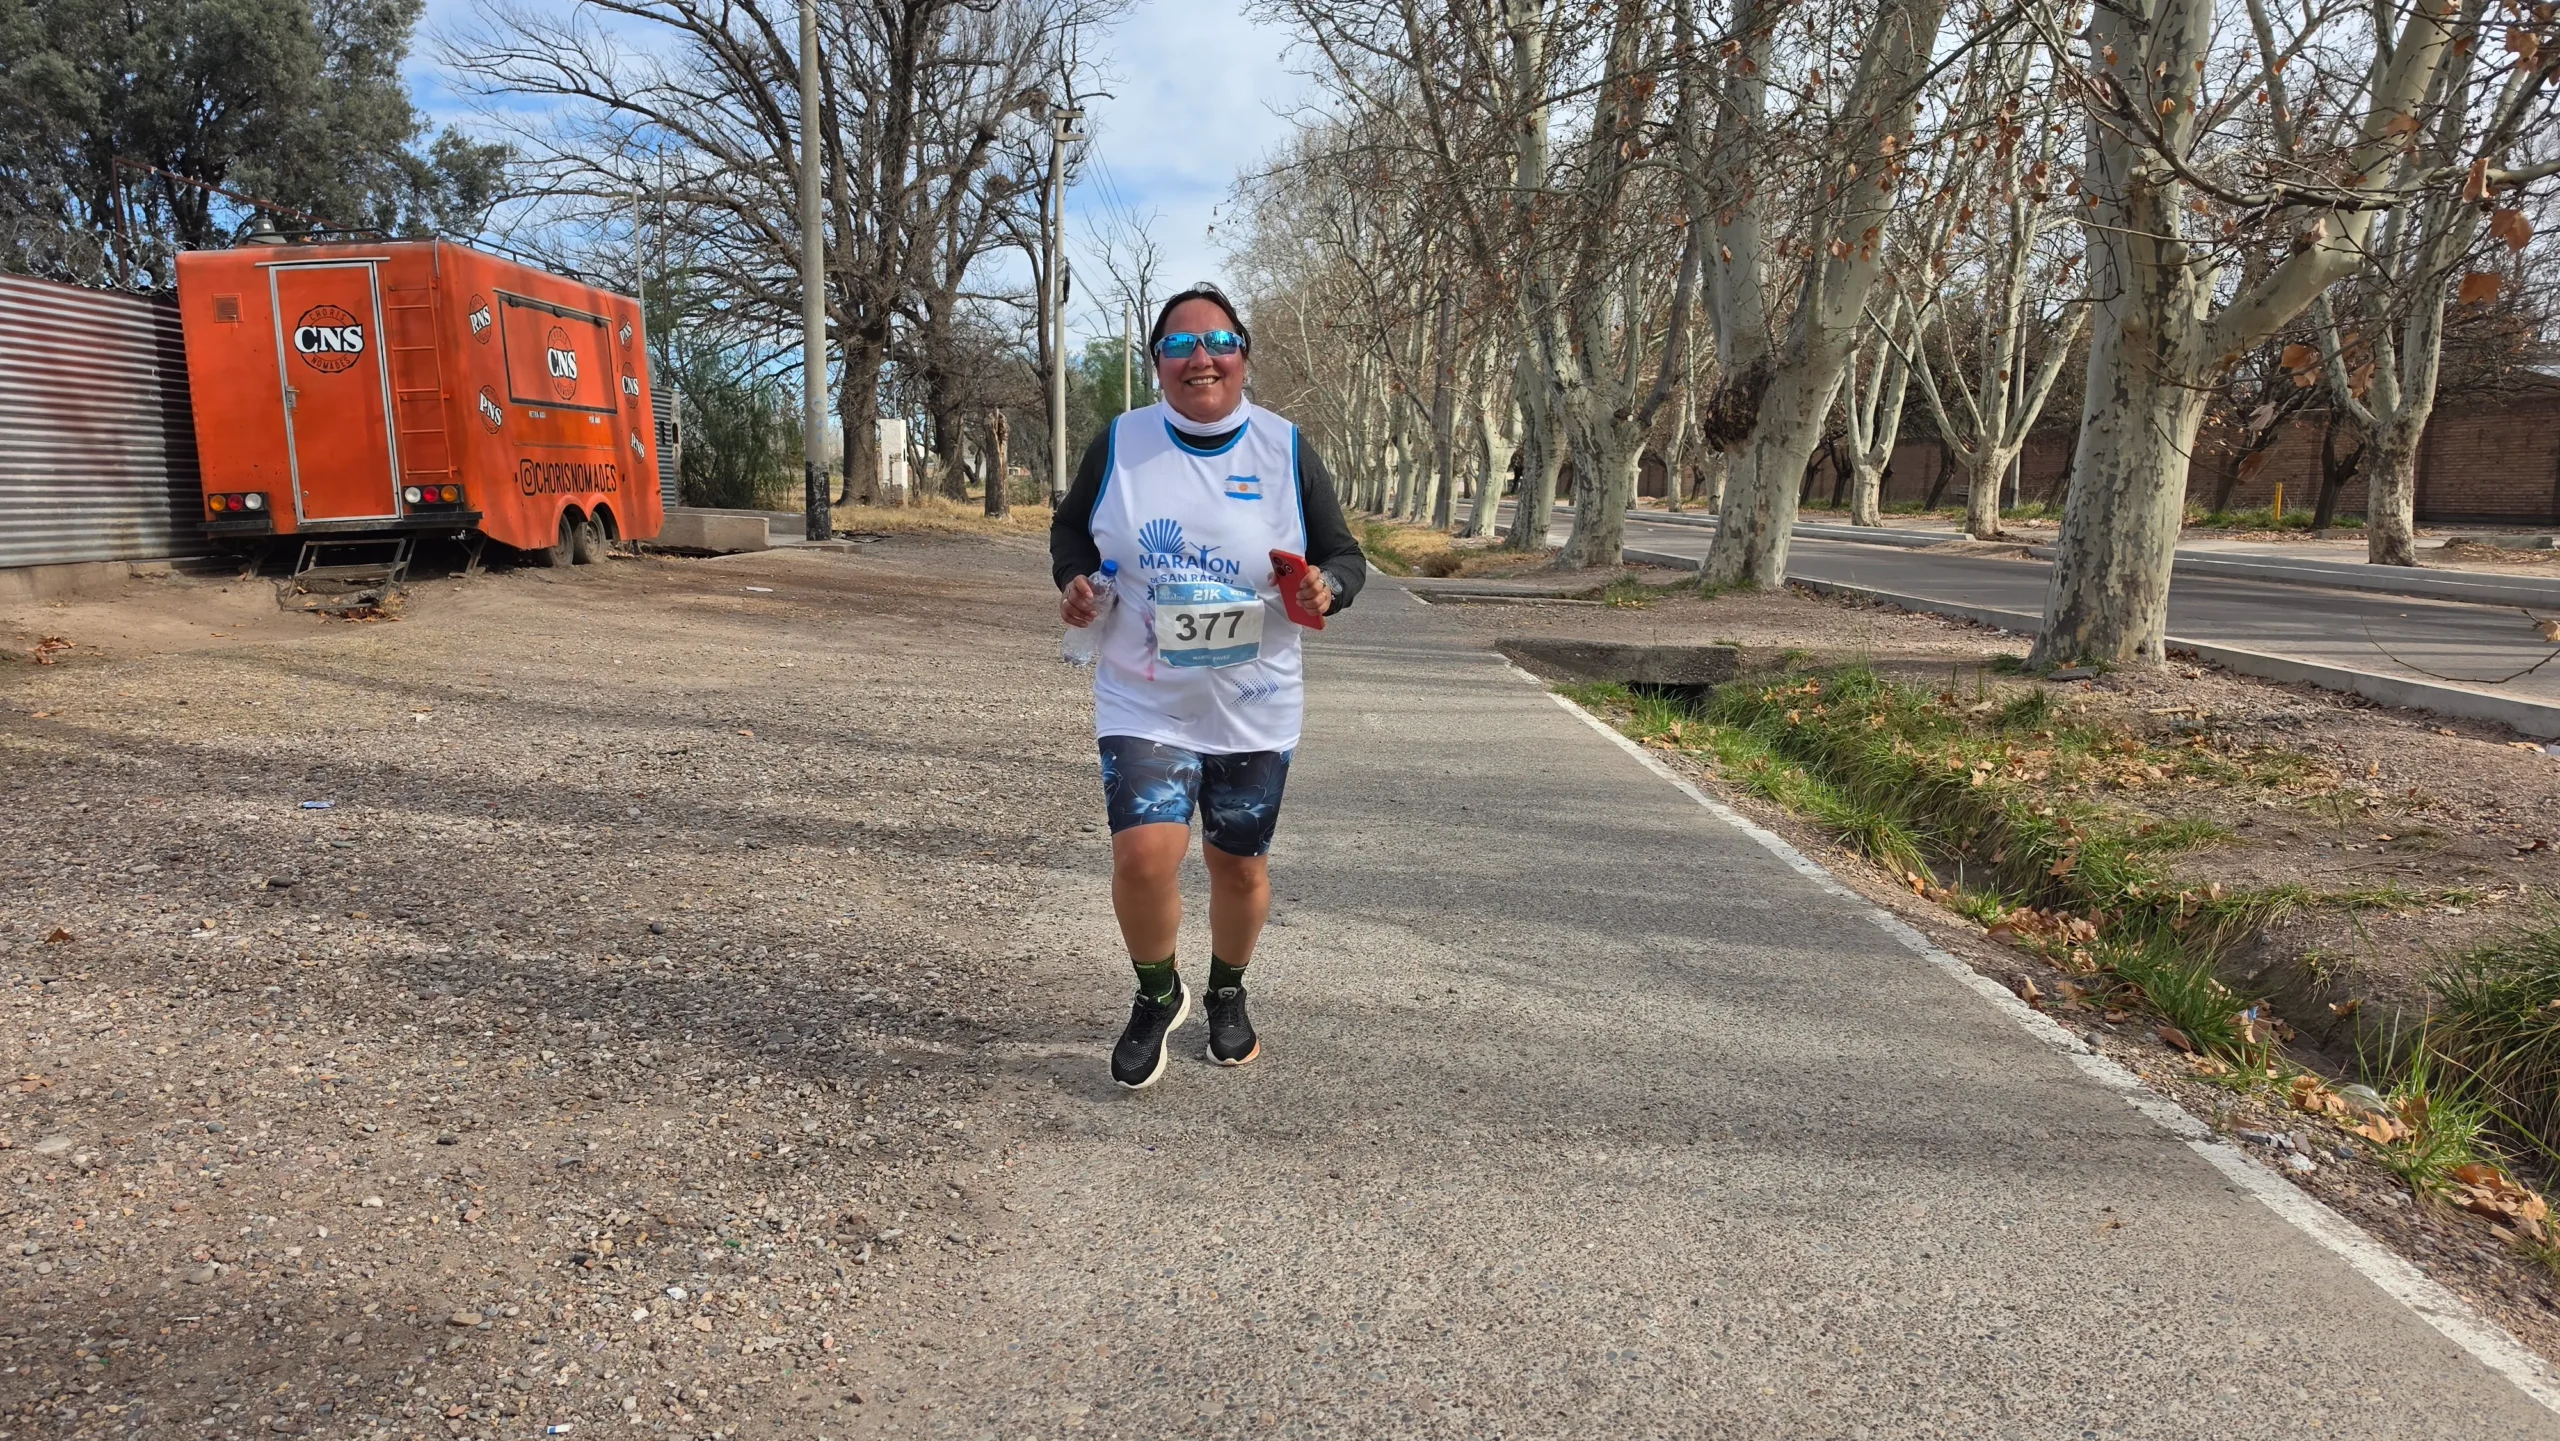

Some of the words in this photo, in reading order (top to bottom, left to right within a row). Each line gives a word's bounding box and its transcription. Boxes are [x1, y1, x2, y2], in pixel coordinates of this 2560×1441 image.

[309, 308, 347, 321] CHORIS
[470, 305, 491, 335] RNS
[294, 326, 364, 353] CNS
[311, 356, 351, 370] NOMADES
[547, 347, 577, 379] CNS
[622, 376, 639, 396] CNS
[479, 392, 502, 426] PNS
[1160, 573, 1187, 583] SAN
[1192, 588, 1222, 602] 21K
[1175, 610, 1245, 641] 377
